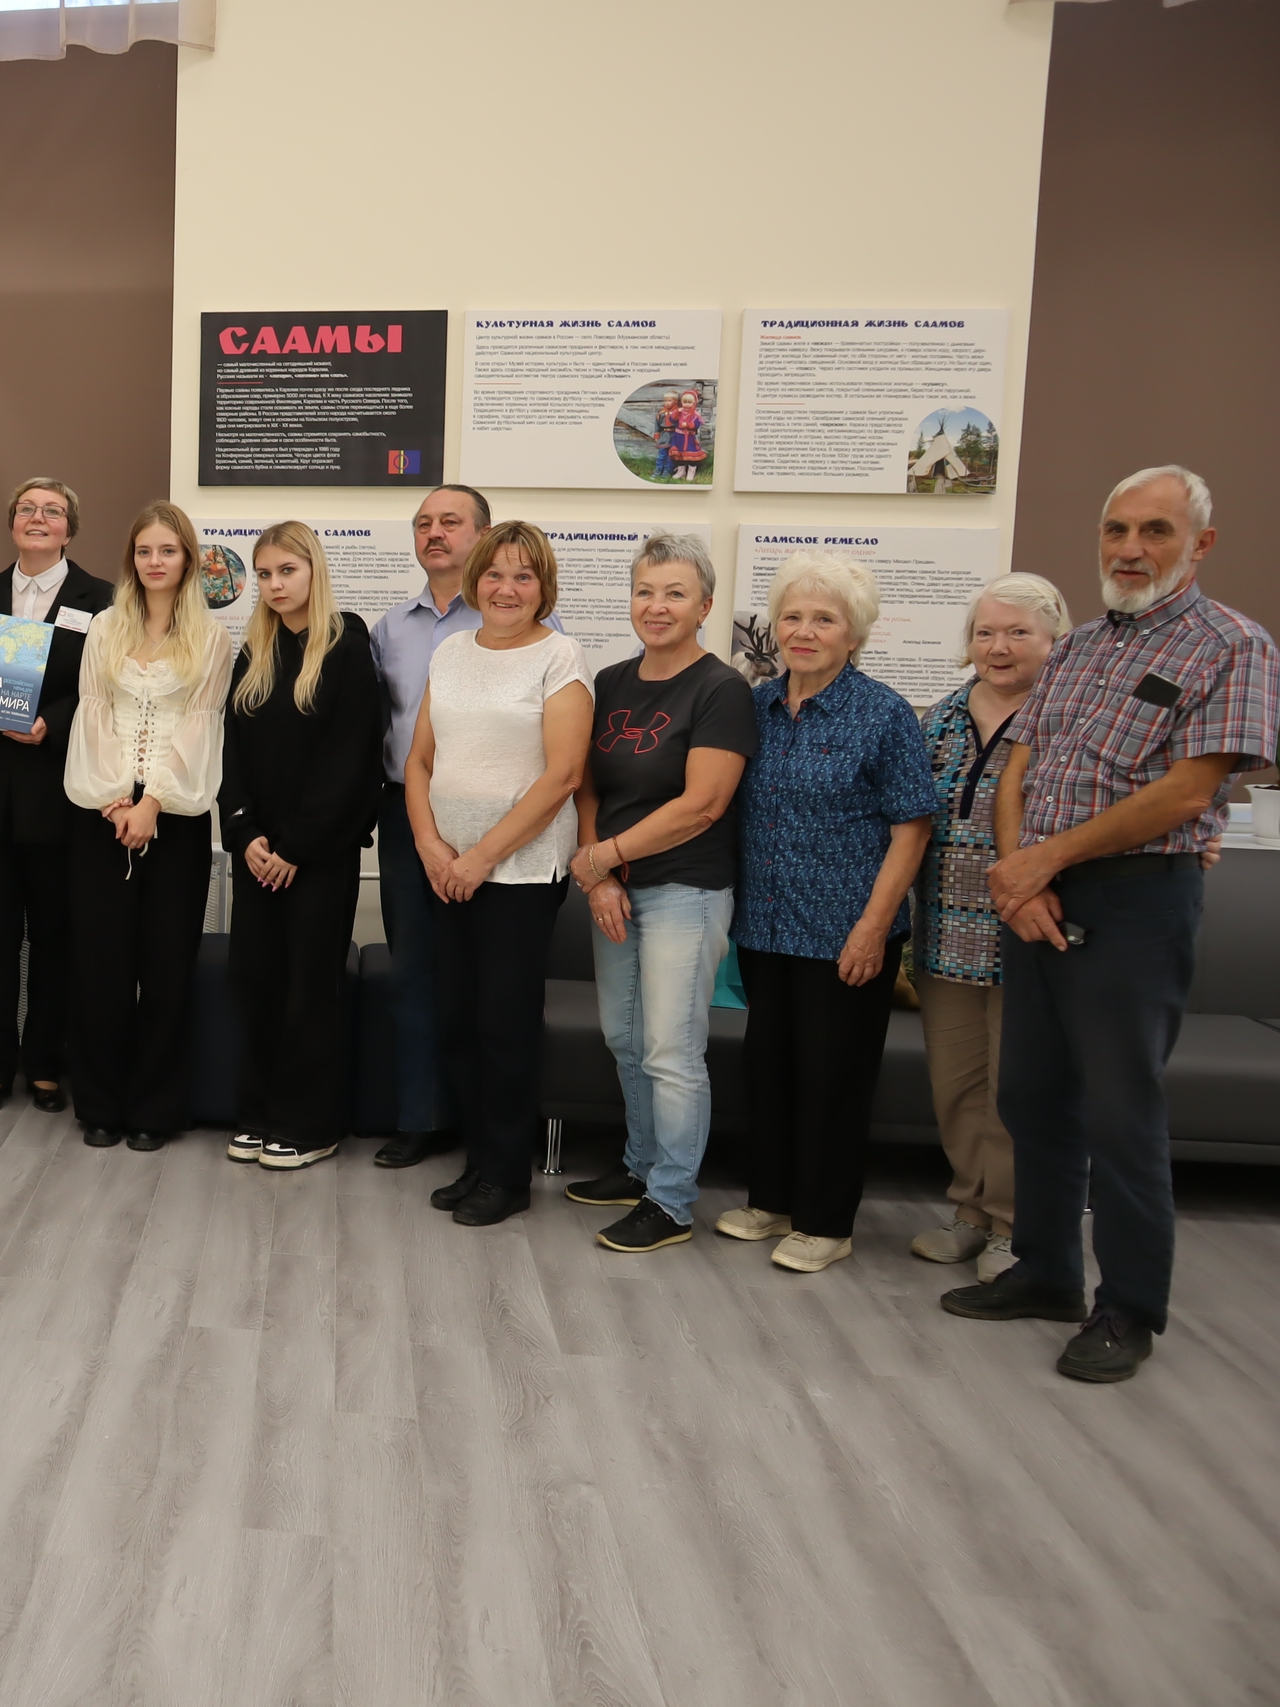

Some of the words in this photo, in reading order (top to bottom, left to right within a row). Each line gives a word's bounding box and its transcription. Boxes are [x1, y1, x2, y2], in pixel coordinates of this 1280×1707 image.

[476, 320, 554, 328] КУЛЬТУРНАЯ
[761, 320, 859, 329] ТРАДИЦИОННАЯ
[218, 324, 402, 354] СААМЫ
[755, 535, 819, 544] СААМСКОЕ
[824, 537, 878, 545] РЕМЕСЛО
